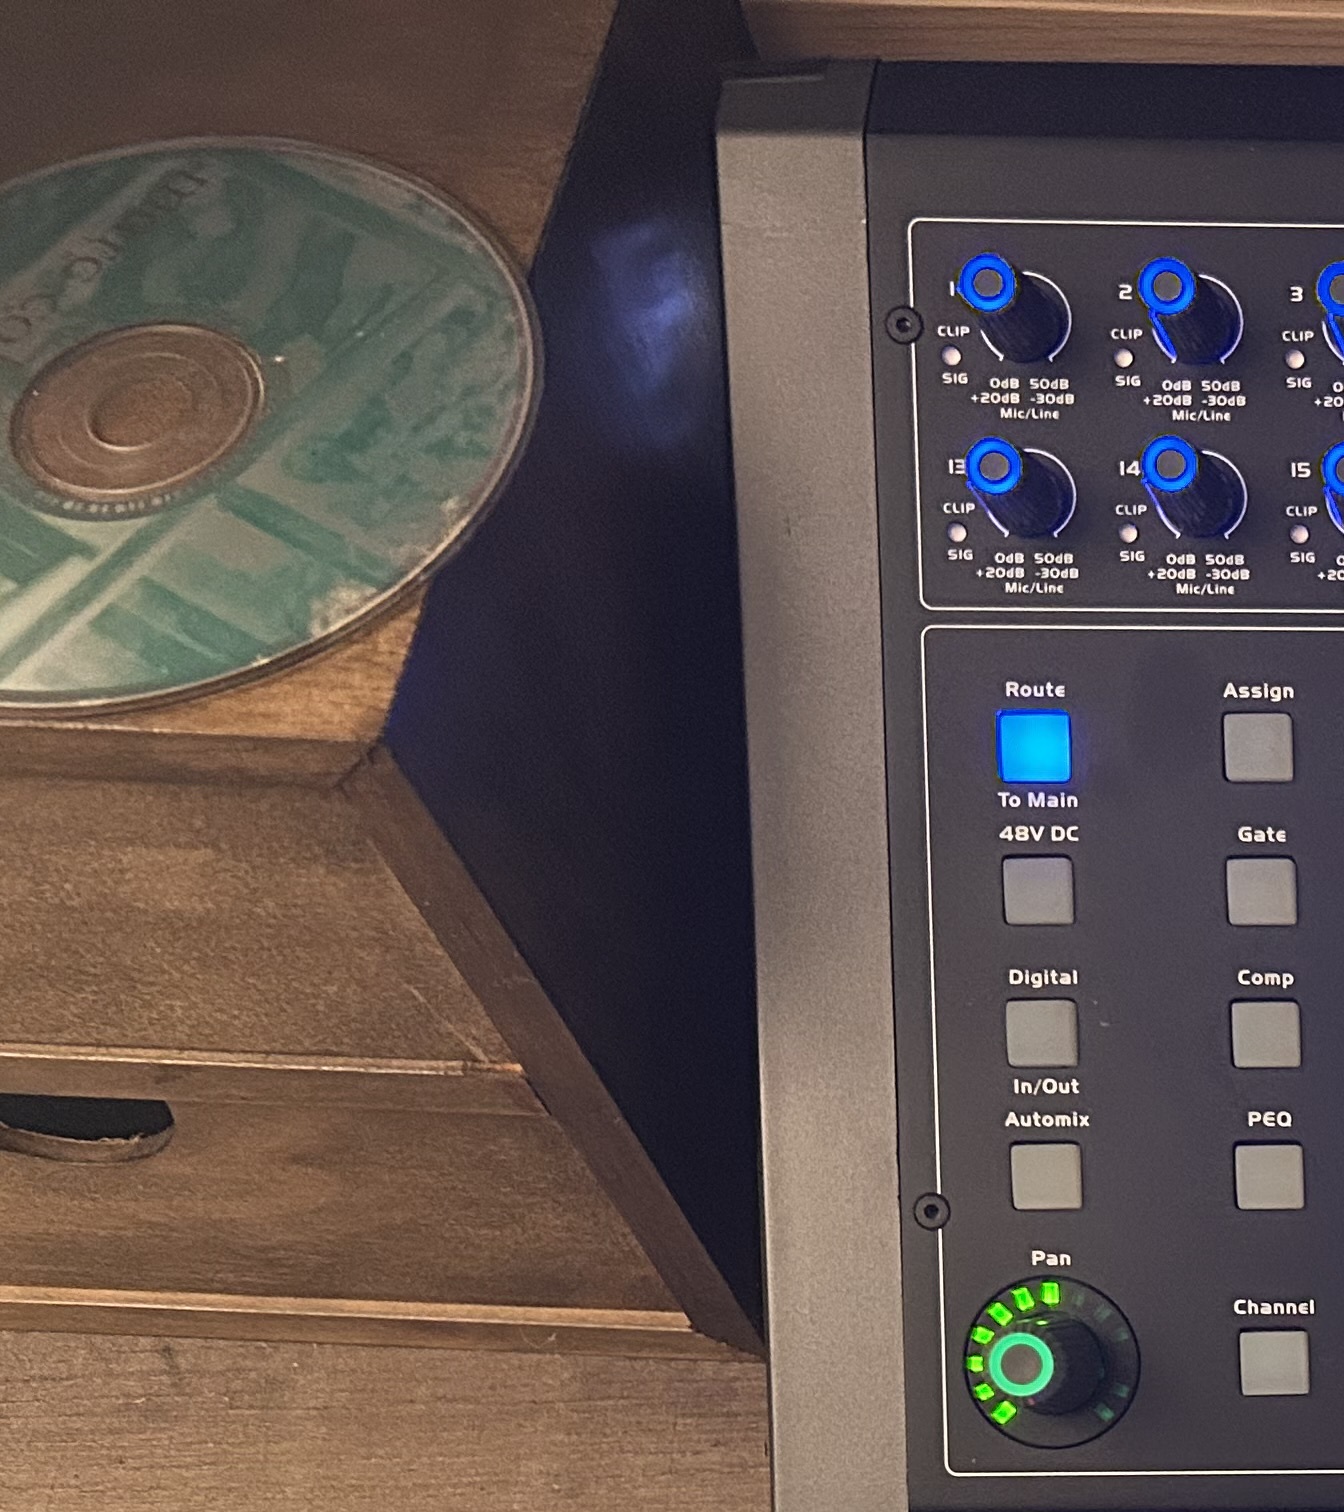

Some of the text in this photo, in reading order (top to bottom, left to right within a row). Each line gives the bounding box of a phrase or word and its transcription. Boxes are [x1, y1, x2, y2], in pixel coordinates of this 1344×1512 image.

[1119, 284, 1132, 299] 2
[938, 326, 969, 336] CLIP
[942, 373, 968, 384] SIG
[990, 378, 1069, 389] 0dB 50dB
[971, 393, 1074, 404] +20dB -30dB
[1001, 408, 1059, 419] Mic/Line
[1292, 463, 1310, 477] 15
[1006, 682, 1065, 697] Route
[1224, 683, 1294, 702] Assign
[998, 792, 1078, 807] To Main
[999, 826, 1079, 841] 48V DC
[1238, 827, 1286, 842] Gate
[1009, 969, 1077, 988] Digital
[1238, 970, 1294, 988] Comp
[1014, 1079, 1079, 1095] In/Out
[1005, 1112, 1089, 1127] Automix
[1248, 1111, 1291, 1127] PEQ
[1032, 1251, 1070, 1265] Pan
[1234, 1299, 1314, 1314] Channel
